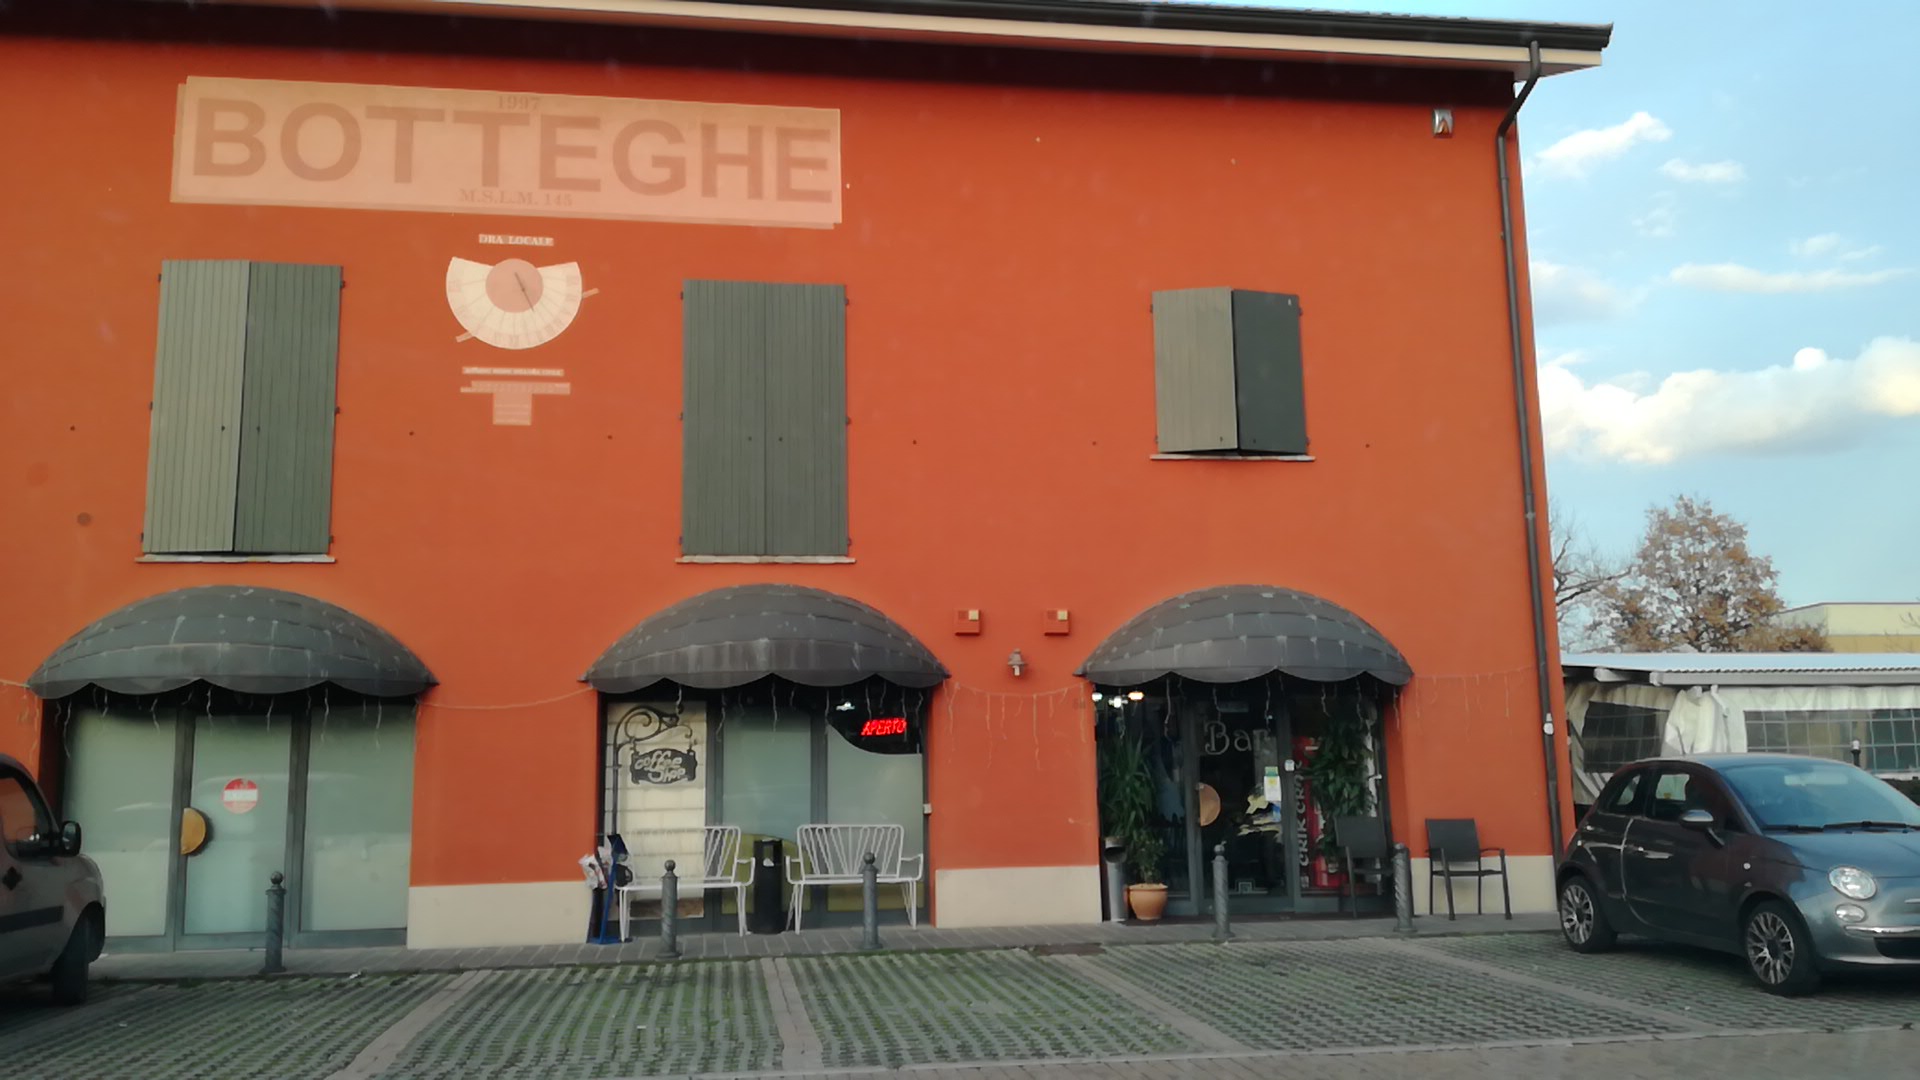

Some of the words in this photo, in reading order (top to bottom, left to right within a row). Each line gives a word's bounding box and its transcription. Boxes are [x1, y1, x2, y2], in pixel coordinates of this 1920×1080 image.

[498, 95, 541, 111] 1997
[193, 97, 833, 202] BOTTEGHE
[861, 718, 907, 736] APERTO
[1205, 720, 1270, 755] Bar
